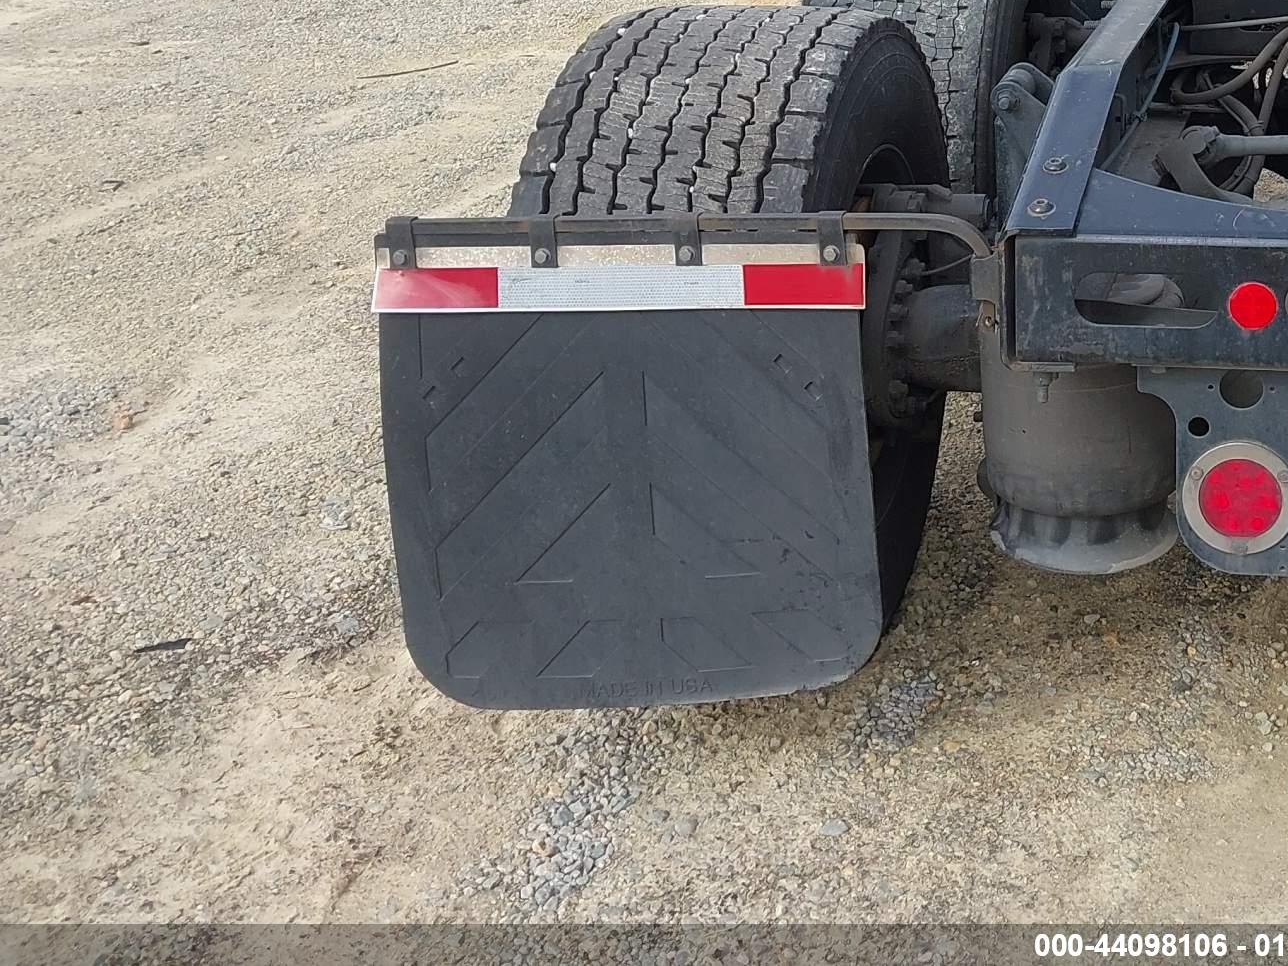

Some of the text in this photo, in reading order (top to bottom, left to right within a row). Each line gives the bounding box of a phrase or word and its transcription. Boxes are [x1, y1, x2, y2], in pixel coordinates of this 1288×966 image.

[581, 678, 714, 699] MADE IN USA
